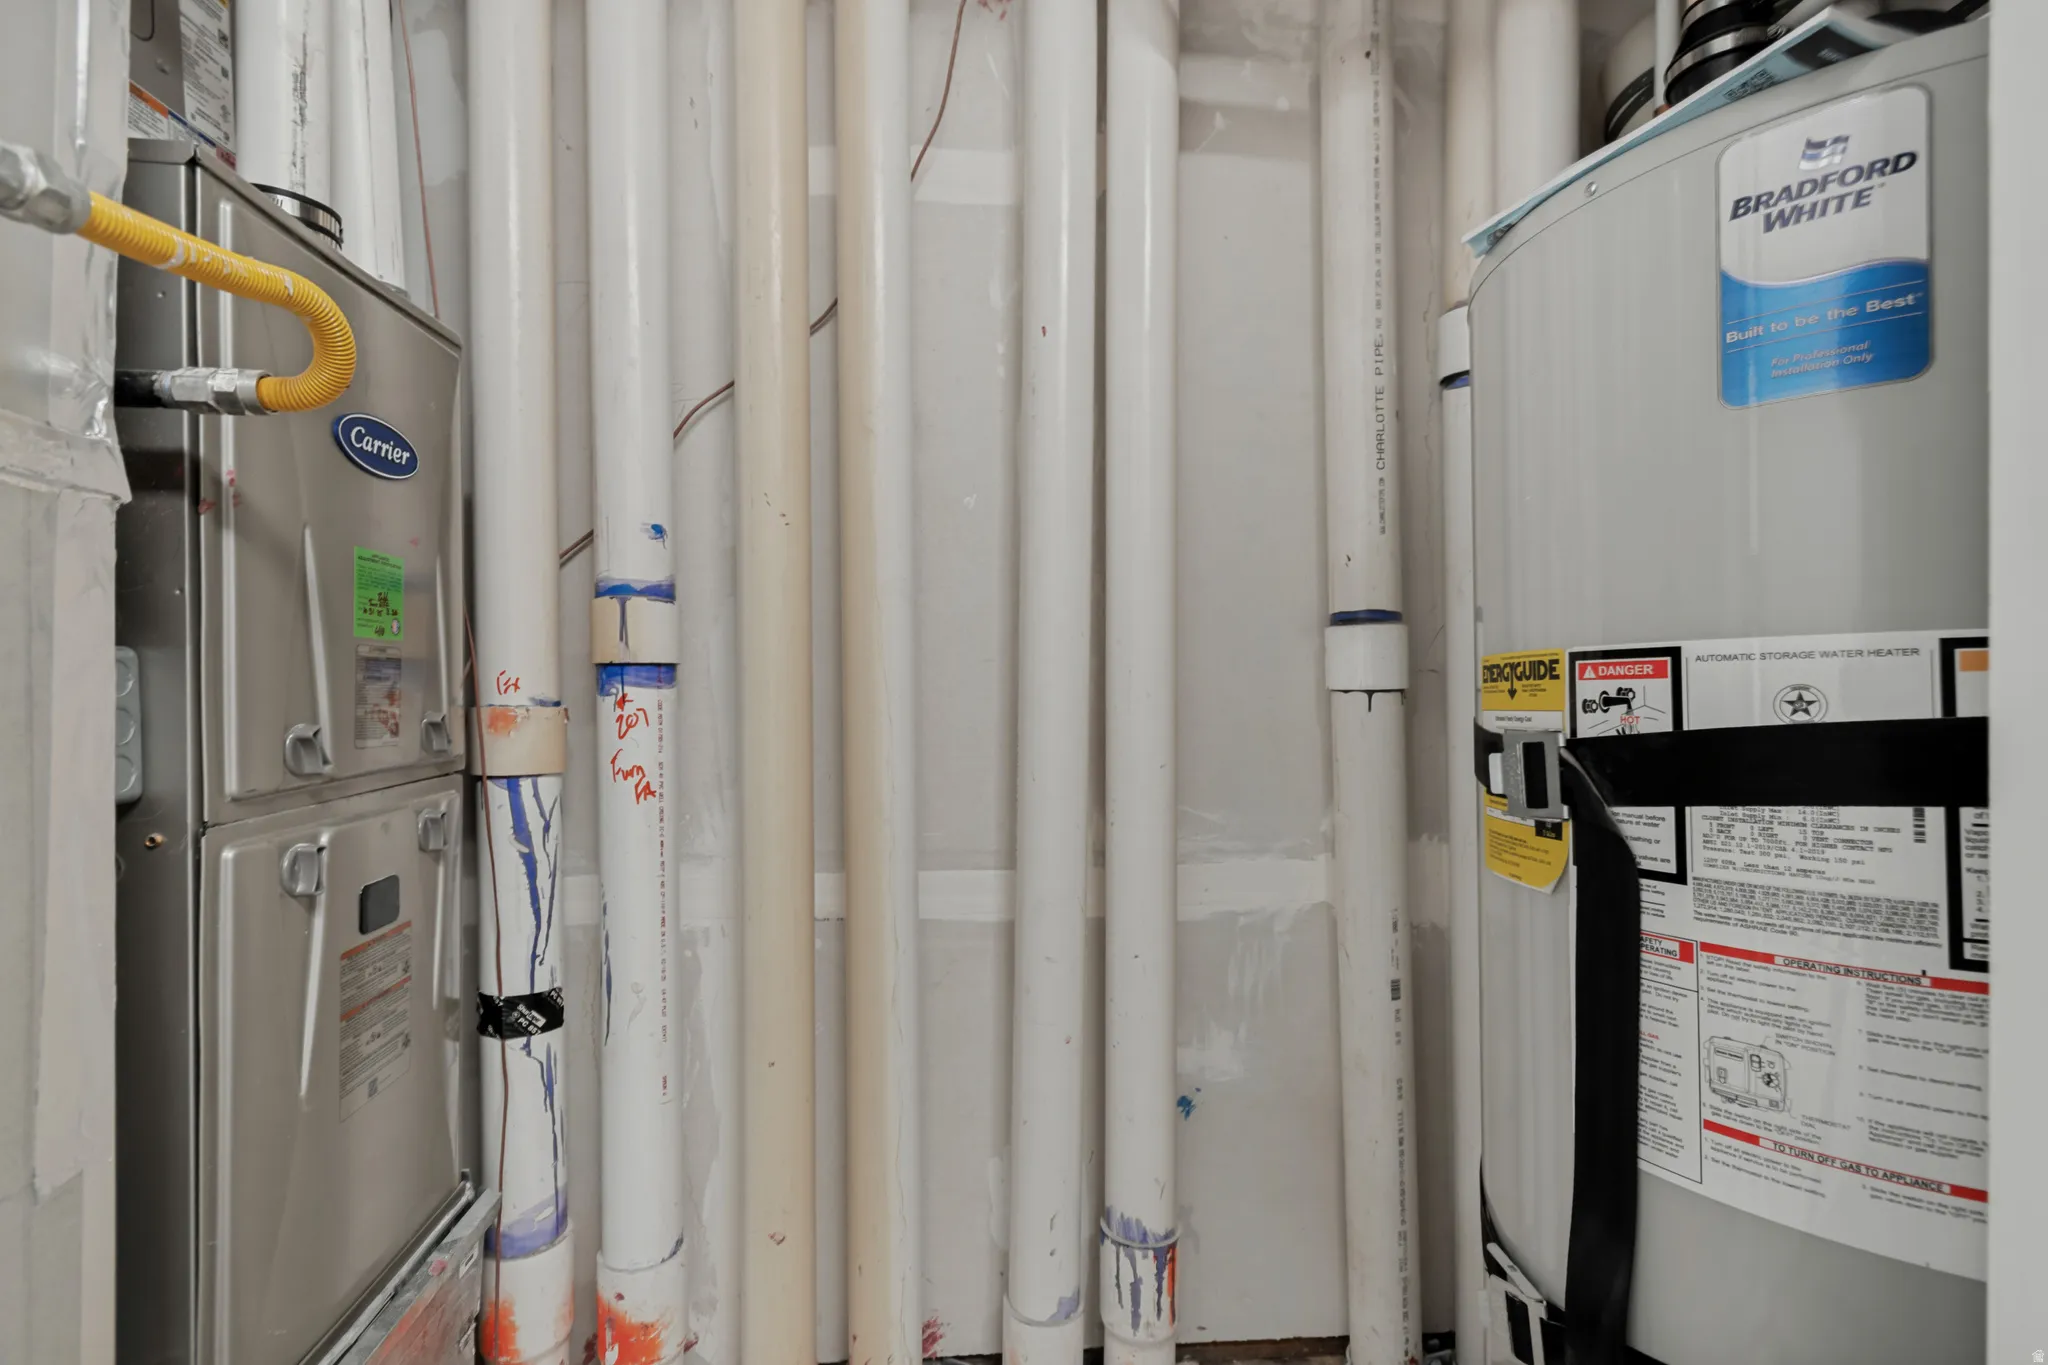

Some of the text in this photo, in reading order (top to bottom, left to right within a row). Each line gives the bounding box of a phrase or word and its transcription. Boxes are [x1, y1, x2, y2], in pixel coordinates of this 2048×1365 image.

[1728, 151, 1917, 222] BRADFORD
[1762, 186, 1874, 234] WHITE
[1726, 325, 1764, 344] Built
[1770, 320, 1788, 333] to
[1794, 311, 1820, 327] be
[1827, 304, 1858, 321] the
[1771, 340, 1871, 367] For Professional
[1771, 352, 1873, 379] Installation Only
[1376, 385, 1386, 471] CHARLOTTE
[350, 428, 410, 465] Carrier
[1695, 647, 1921, 663] AUTOMATIC STORAGE WATER HEATER
[1598, 664, 1654, 677] DANGER
[1620, 716, 1640, 724] HOT
[1783, 958, 1922, 985] OPERATING INSTRUCTIONS
[517, 1017, 529, 1027] PC
[1773, 1142, 1945, 1193] TO TURN OFF GAS TO APPLIANCE
